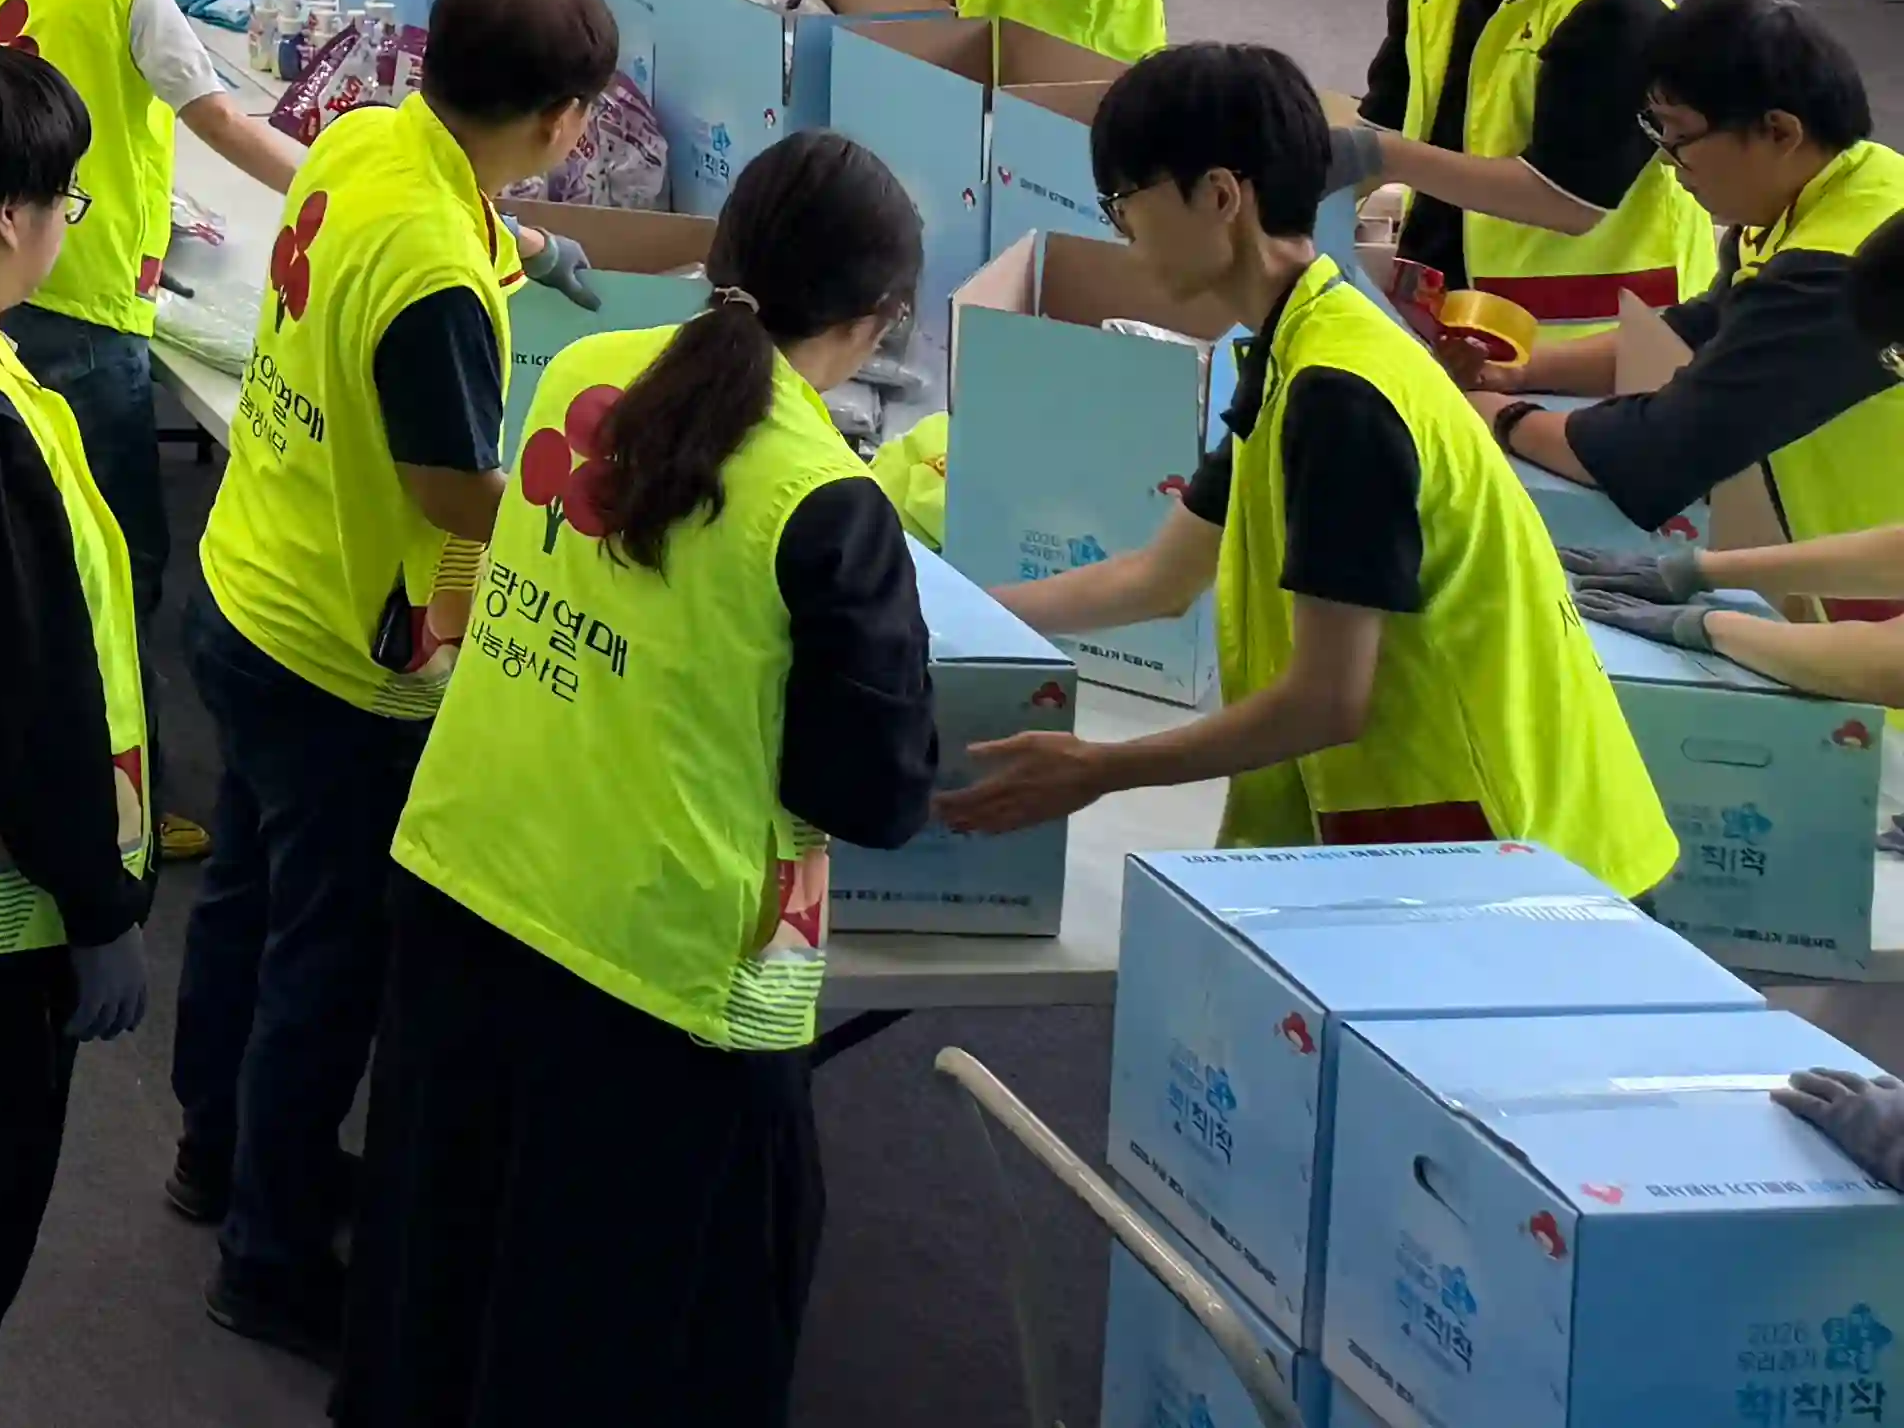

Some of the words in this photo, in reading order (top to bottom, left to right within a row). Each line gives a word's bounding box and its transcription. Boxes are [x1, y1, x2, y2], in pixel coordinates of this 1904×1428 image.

[247, 337, 325, 444] 의열매
[471, 618, 580, 704] 나눔봉사단
[485, 561, 629, 680] 랑의열매
